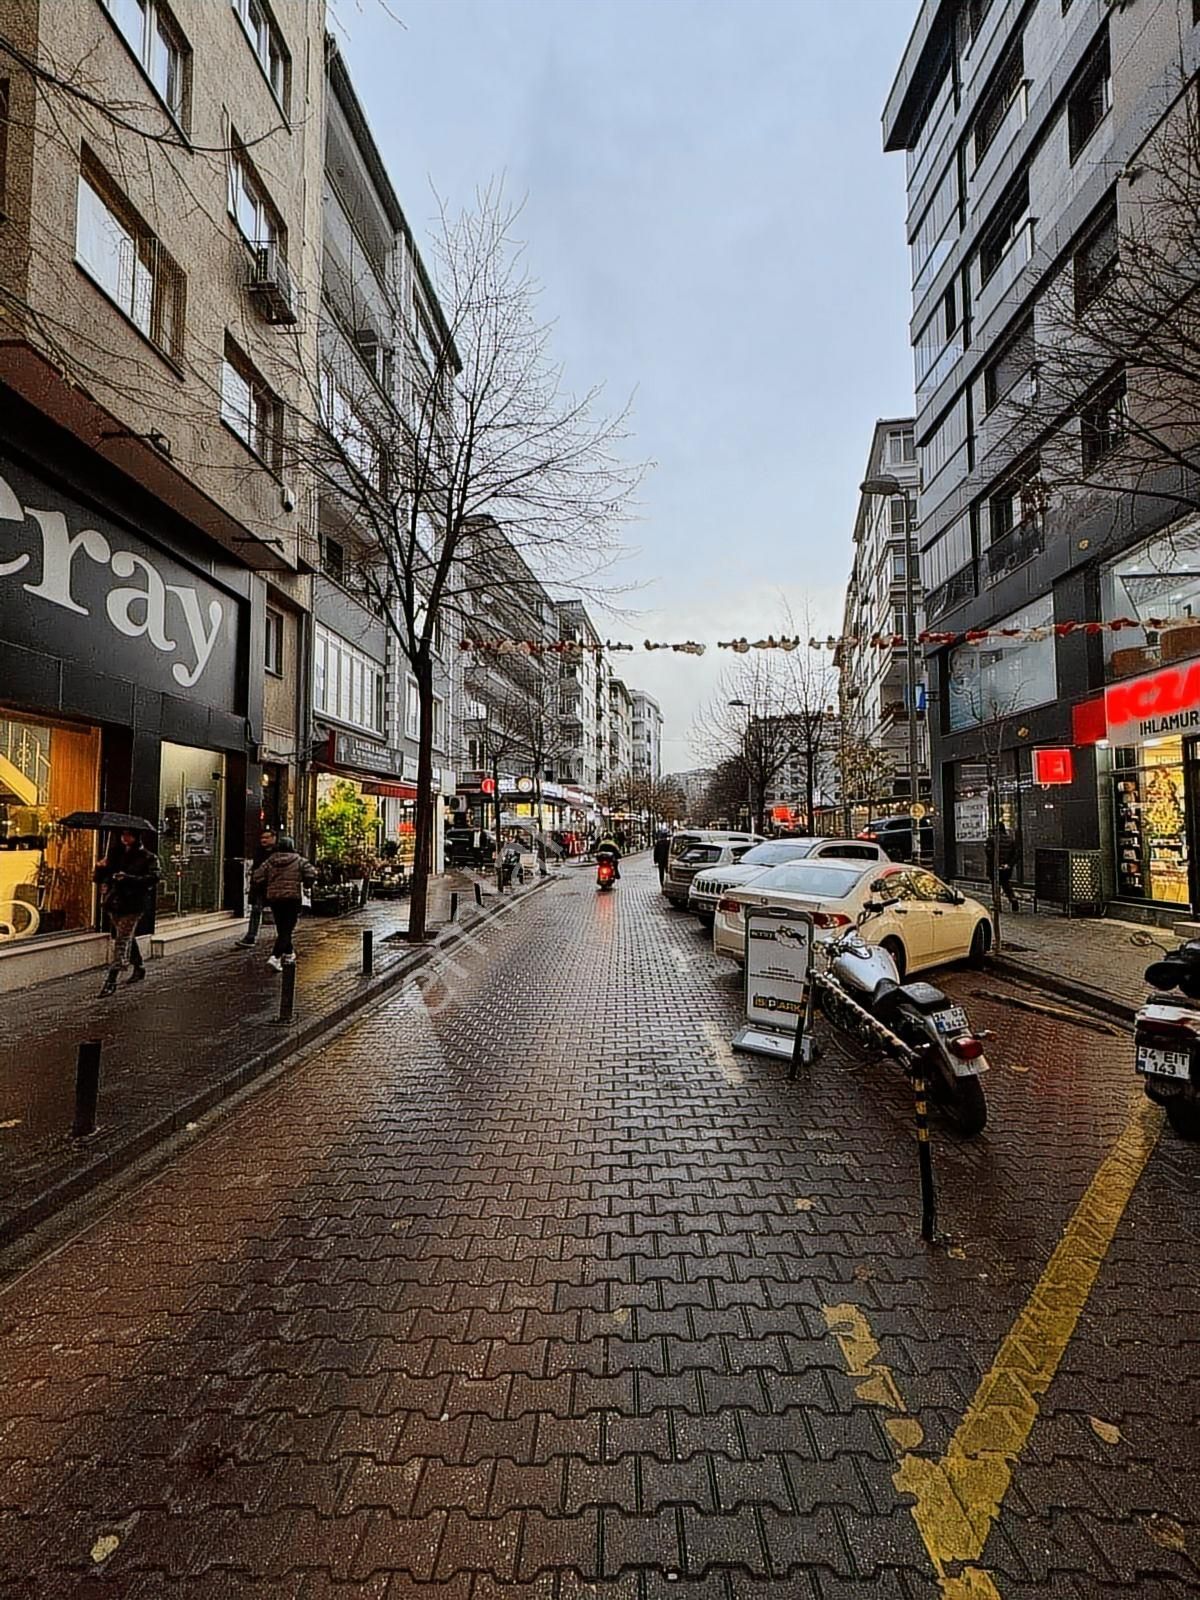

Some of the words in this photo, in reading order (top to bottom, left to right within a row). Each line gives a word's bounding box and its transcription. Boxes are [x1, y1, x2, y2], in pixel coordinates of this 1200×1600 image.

[1139, 710, 1199, 736] IHLAMUR
[1140, 1048, 1156, 1060] 34
[1164, 1052, 1188, 1065] EIT
[1152, 1062, 1177, 1075] 143
